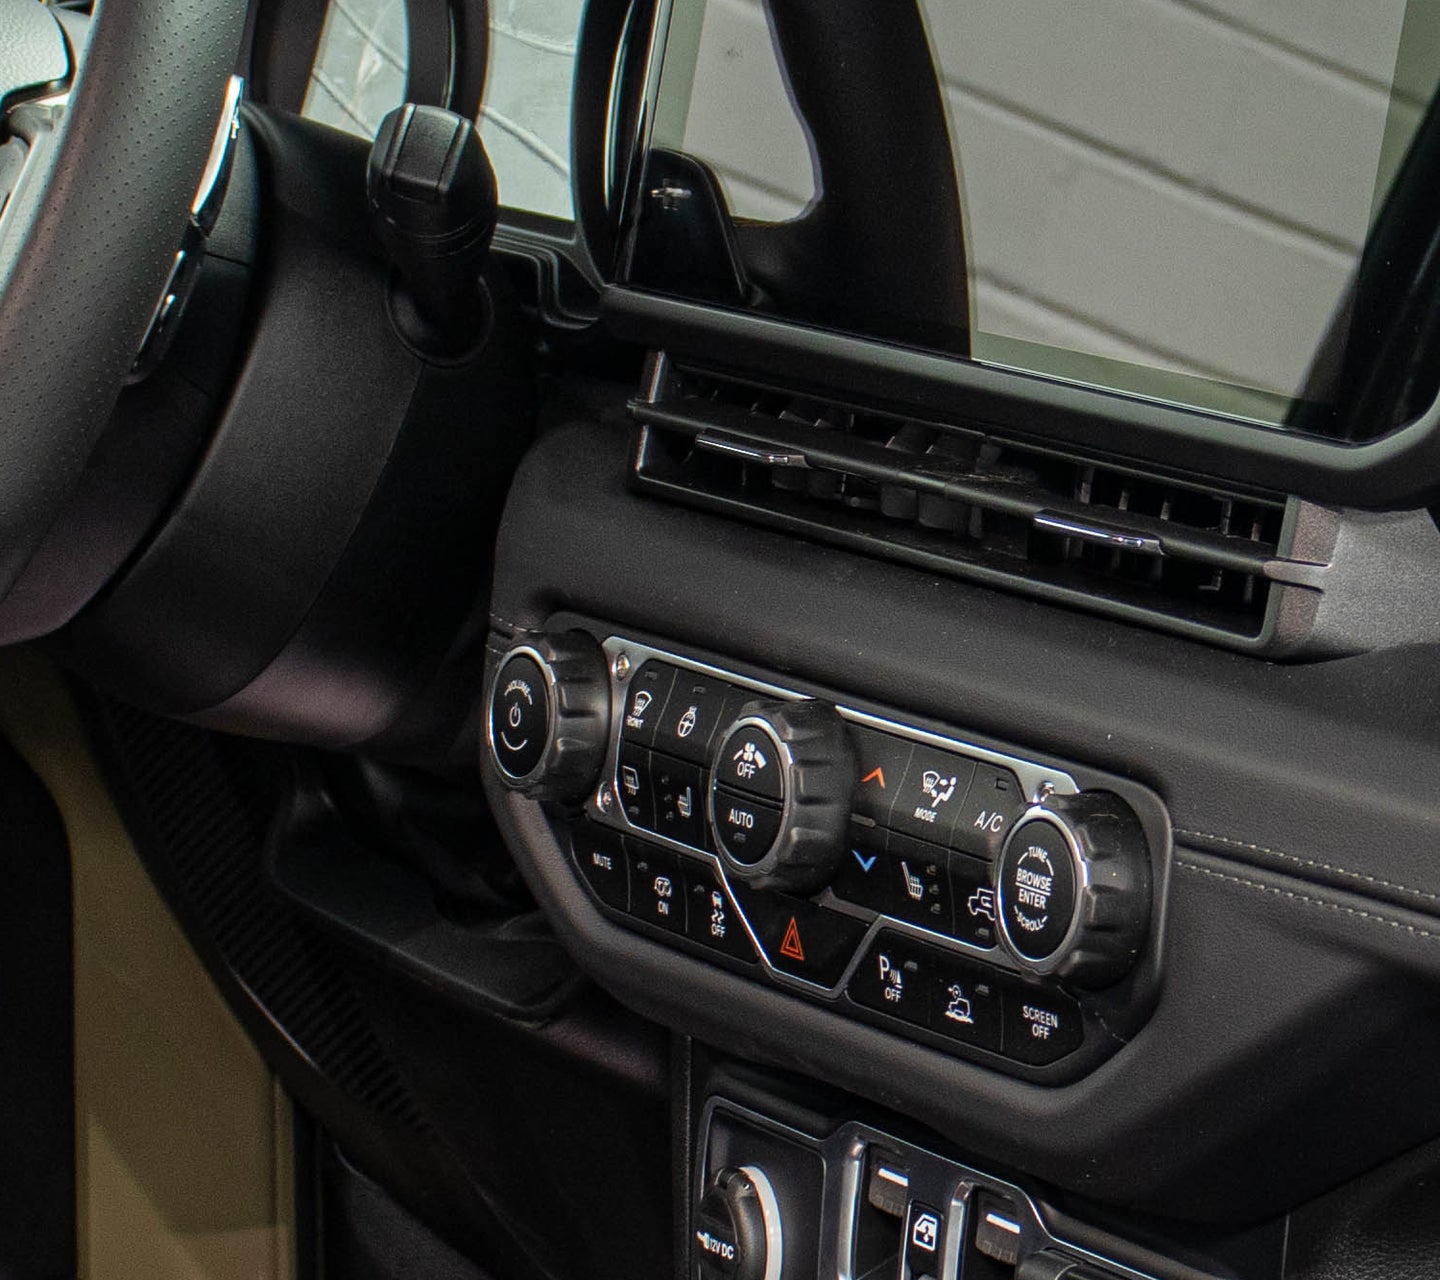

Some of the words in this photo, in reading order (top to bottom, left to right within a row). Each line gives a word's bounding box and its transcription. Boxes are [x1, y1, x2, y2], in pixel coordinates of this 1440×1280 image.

[737, 762, 756, 779] OFF
[728, 809, 753, 829] AUTO
[914, 807, 938, 823] MODE
[974, 810, 1003, 832] A/C
[593, 852, 612, 870] MUTE
[1028, 846, 1048, 863] TUNE
[1016, 867, 1052, 891] BROWSE
[1019, 888, 1046, 909] ENTER
[658, 901, 669, 915] ON
[1017, 912, 1044, 931] SCROLL
[711, 924, 725, 938] OFF
[885, 987, 901, 1002] OFF
[1023, 1005, 1058, 1028] SCREEN
[1032, 1024, 1049, 1040] OFF
[721, 1243, 734, 1260] DC
